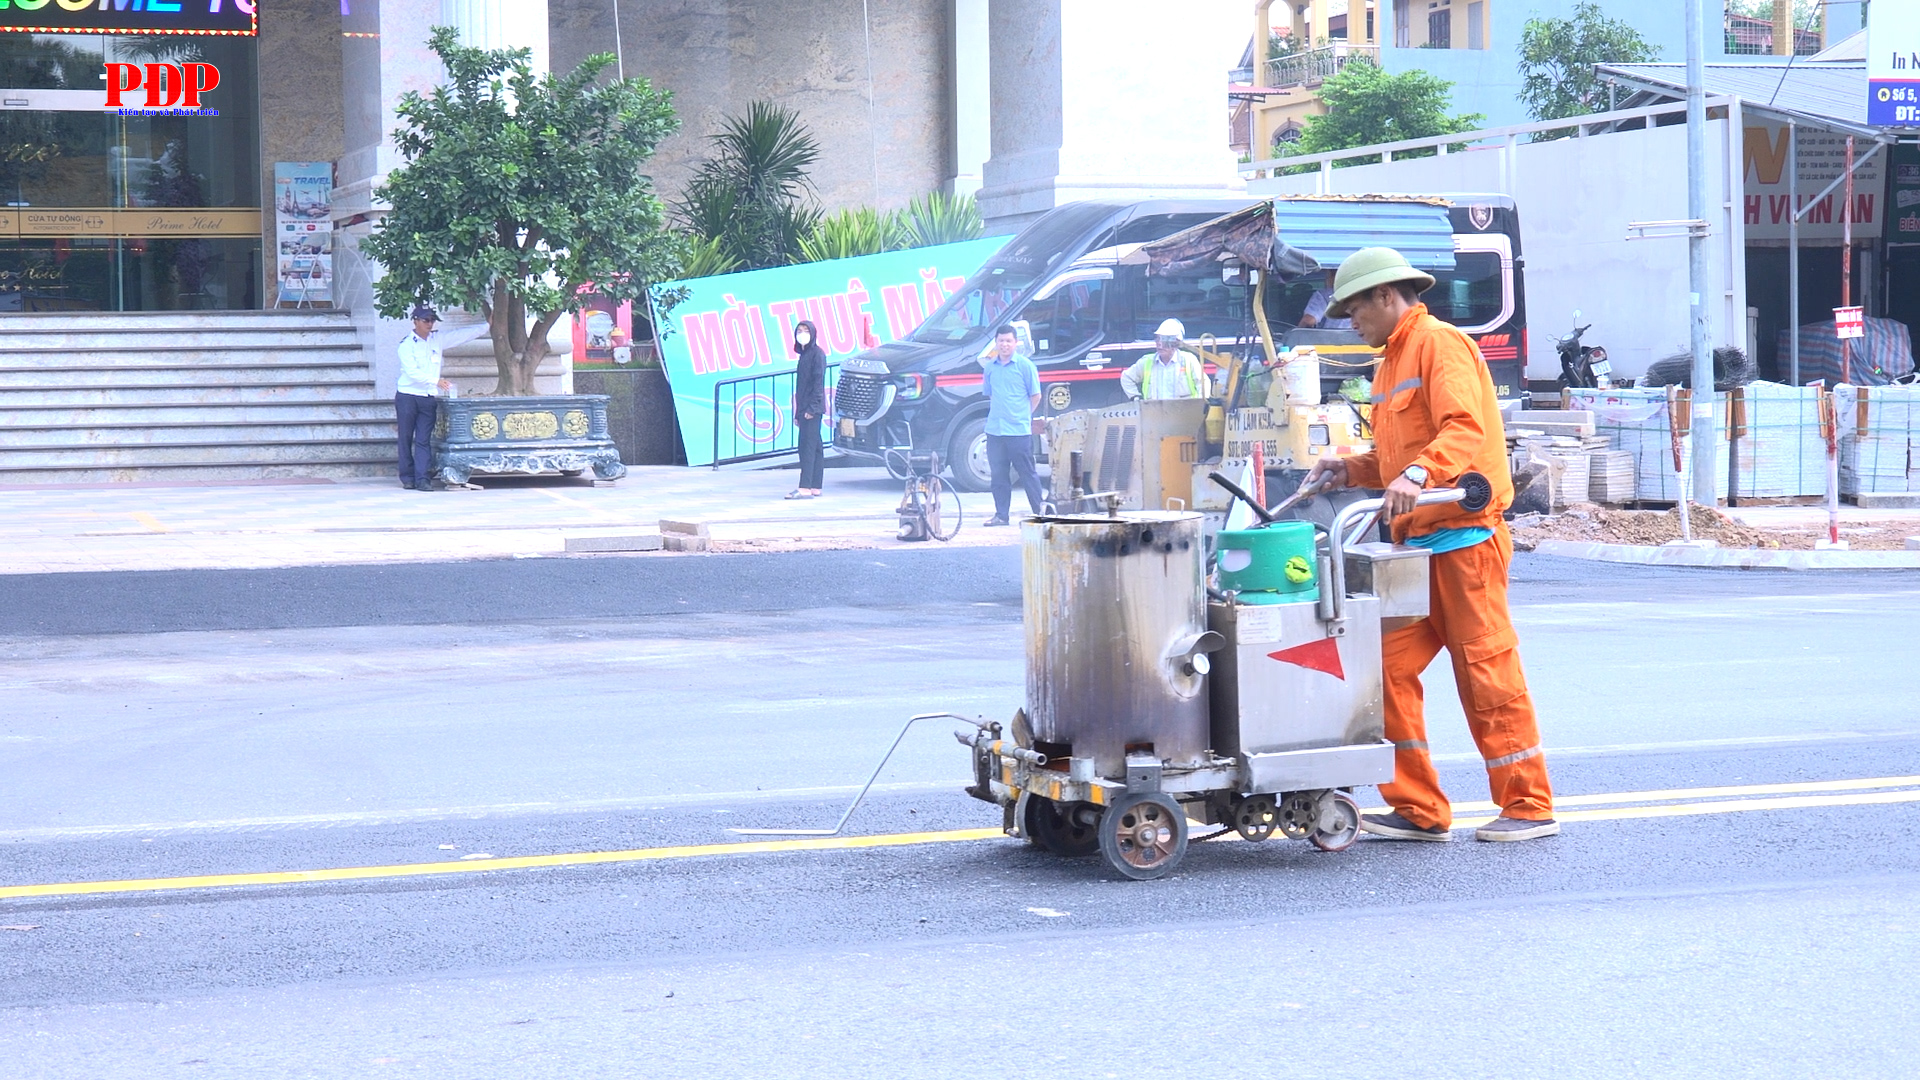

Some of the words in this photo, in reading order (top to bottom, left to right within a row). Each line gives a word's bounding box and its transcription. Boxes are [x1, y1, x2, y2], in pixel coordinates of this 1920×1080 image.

[1892, 86, 1906, 101] Số
[1907, 88, 1918, 103] 5,
[1895, 105, 1920, 121] ĐT:
[28, 213, 45, 222] CỬA
[46, 214, 58, 223] TỰ
[59, 213, 81, 223] ĐỘNG
[146, 216, 184, 229] Prime
[188, 216, 223, 229] Hotel
[683, 294, 772, 374] MỜI
[770, 279, 880, 361] THUÊ
